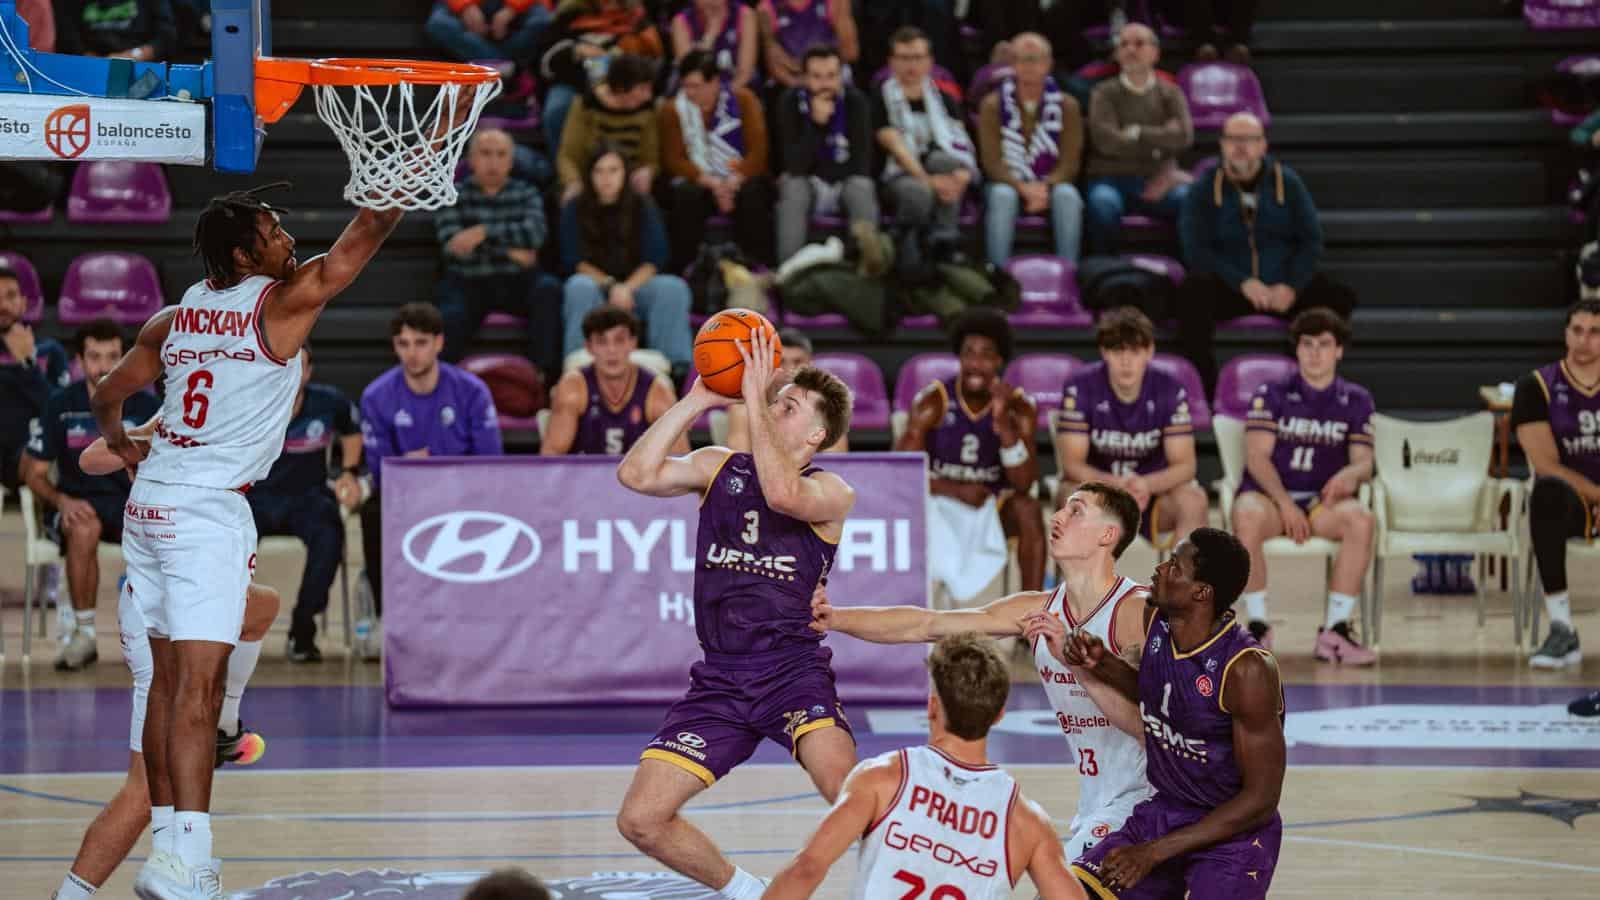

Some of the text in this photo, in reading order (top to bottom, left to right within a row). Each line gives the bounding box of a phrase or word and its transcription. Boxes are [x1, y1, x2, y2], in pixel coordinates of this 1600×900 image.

[0, 117, 30, 134] sto
[174, 307, 252, 337] MCKAY
[182, 369, 214, 429] 6
[605, 427, 624, 455] 5
[1090, 428, 1162, 450] UEMC
[1278, 416, 1349, 442] UEMC
[960, 432, 979, 463] 2
[1289, 446, 1314, 471] 11
[741, 510, 760, 544] 3
[664, 740, 707, 761] HYUNDAI
[908, 784, 998, 839] PRADO
[884, 820, 998, 877] Geoxa
